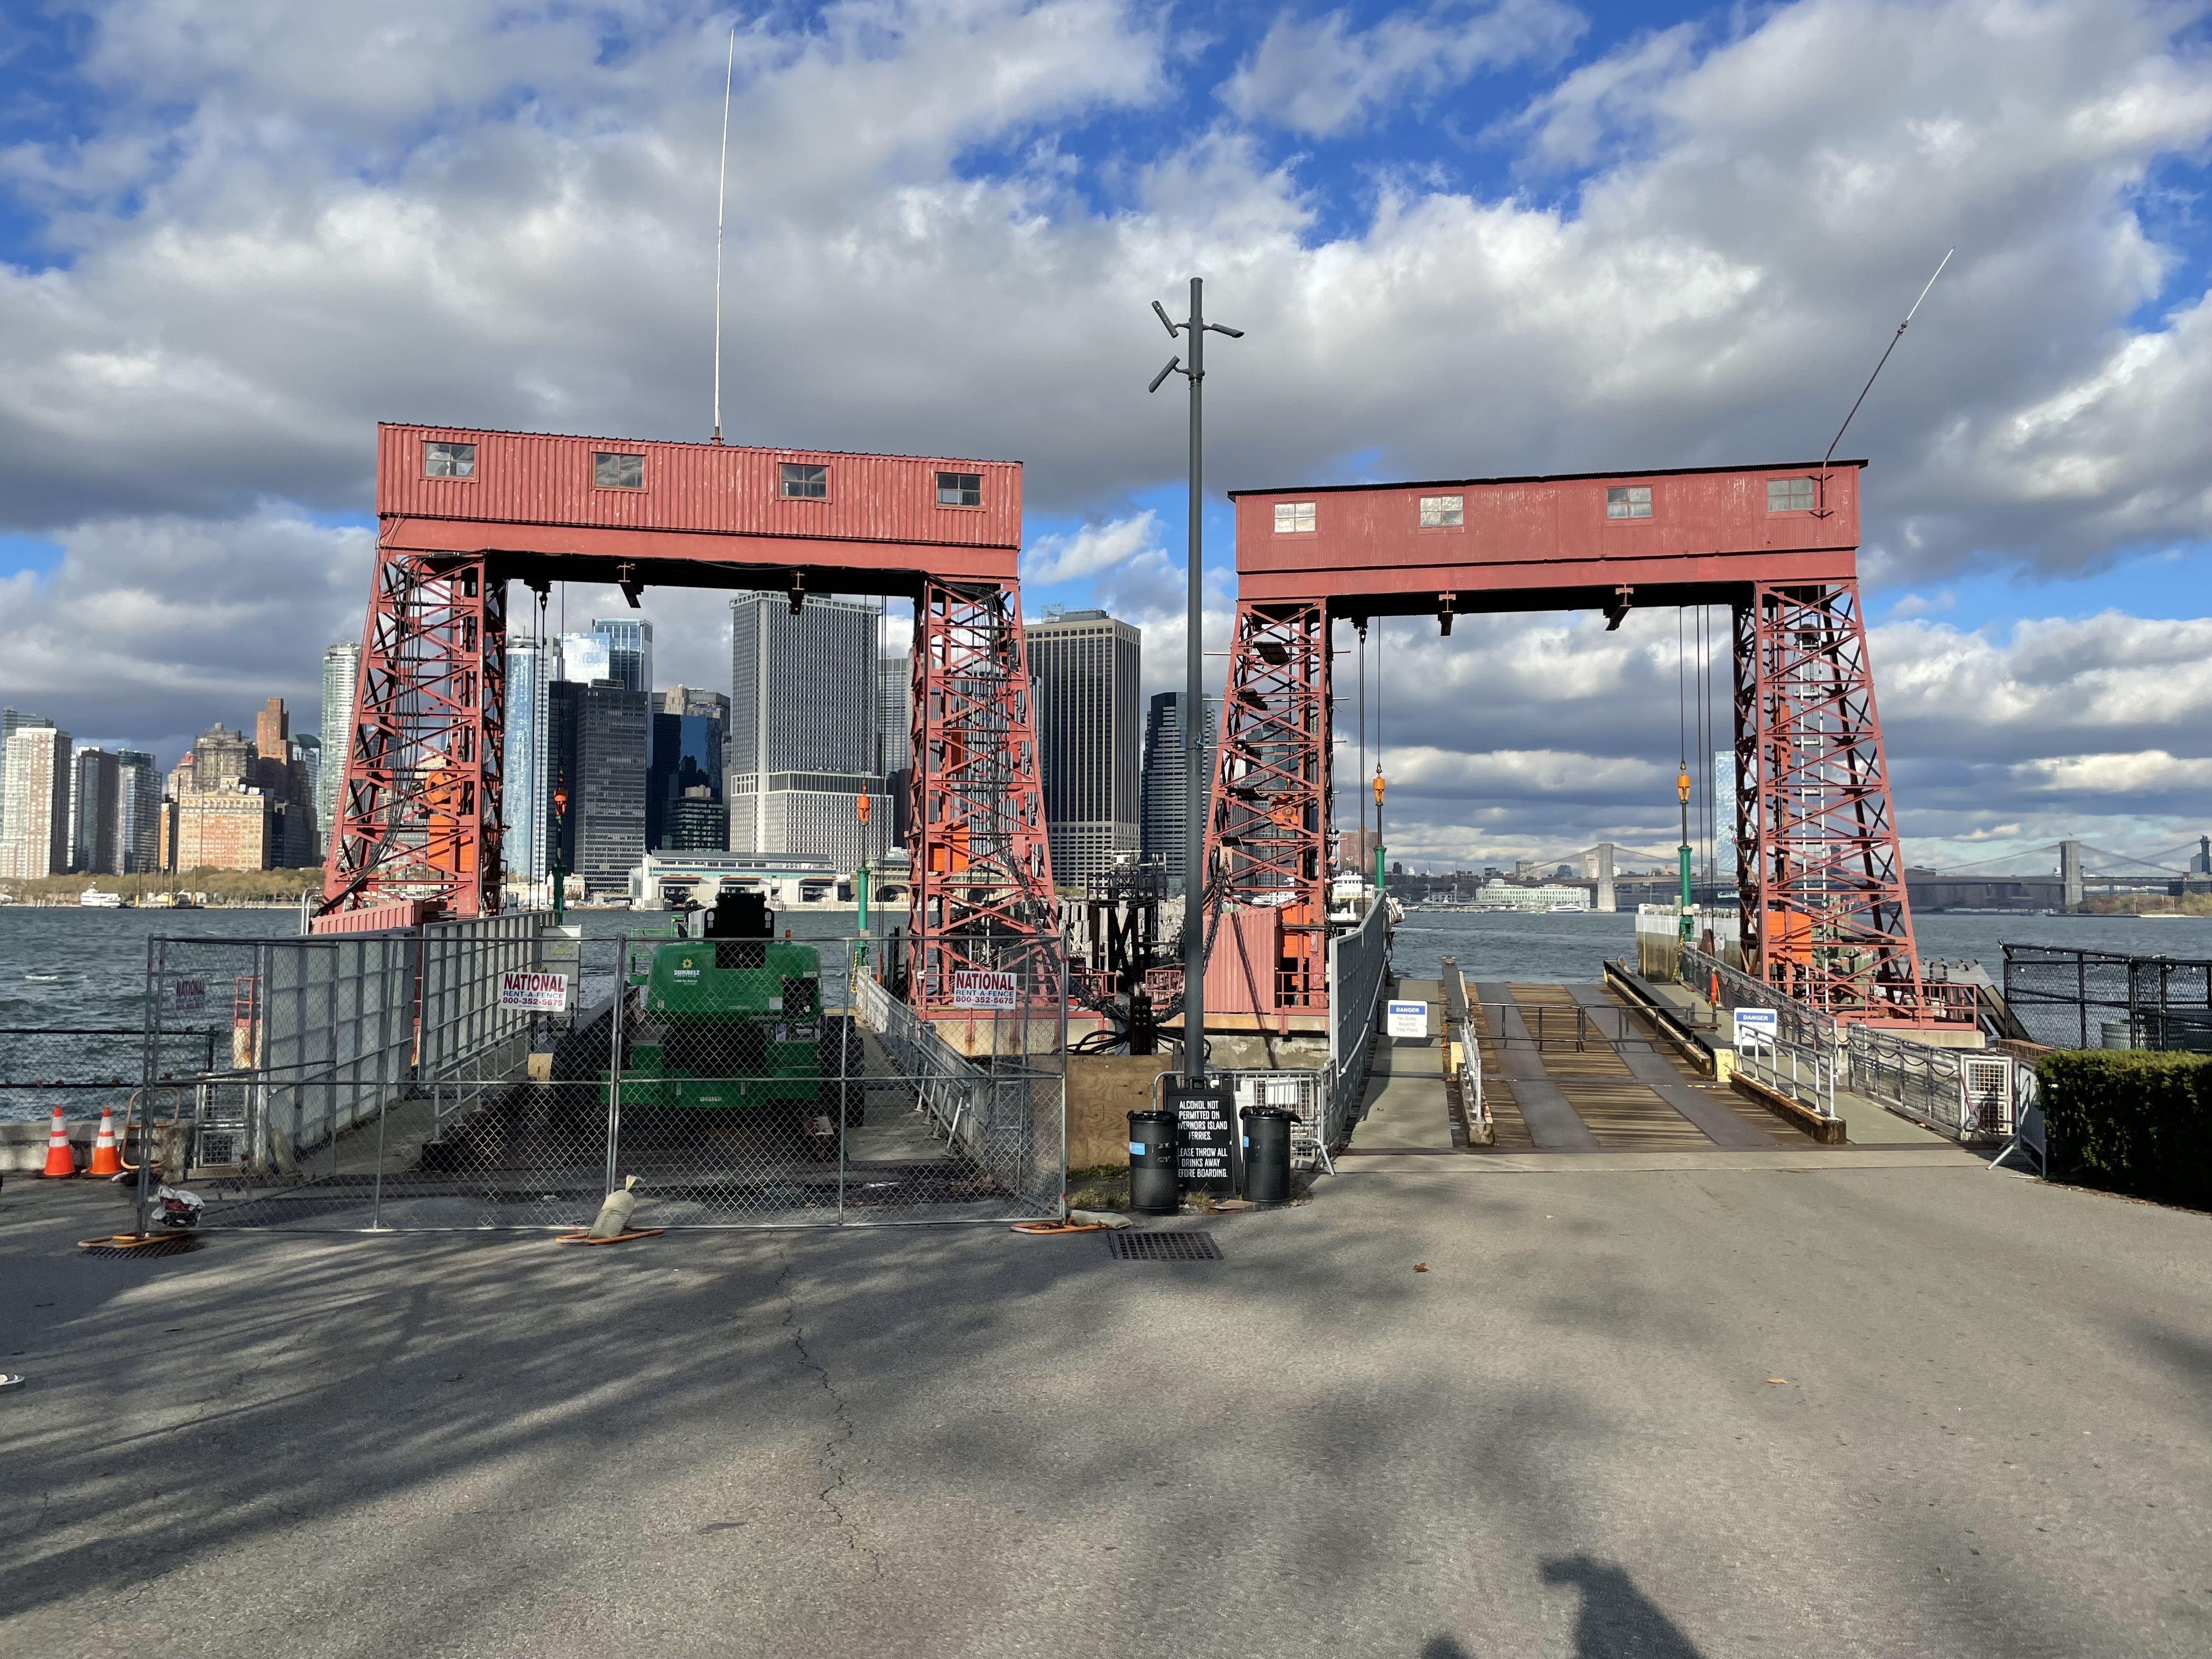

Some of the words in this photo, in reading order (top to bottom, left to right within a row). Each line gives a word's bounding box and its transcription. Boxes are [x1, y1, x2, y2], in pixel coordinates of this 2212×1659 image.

[504, 973, 565, 992] NATIONAL
[956, 973, 1014, 991] NATIONAL
[503, 991, 564, 999] RENT-A-FENCE
[503, 997, 563, 1006] 800-352-5675
[956, 996, 1013, 1004] 800-352-5675
[1179, 1101, 1206, 1109] ALCOHOL
[1207, 1101, 1219, 1109] NOT
[1178, 1110, 1210, 1119] PERMITTED
[1211, 1110, 1220, 1119] ON
[1177, 1121, 1206, 1130] VERNORS
[1207, 1121, 1228, 1130] ISLAND
[1188, 1131, 1212, 1140] FERRIES.
[1195, 1148, 1216, 1156] THROW
[1217, 1148, 1228, 1156] ALL
[1182, 1158, 1203, 1167] DRINKS
[1204, 1158, 1221, 1167] AWAY
[1178, 1169, 1195, 1177] EFORE
[1197, 1169, 1228, 1177] BOARDING.
